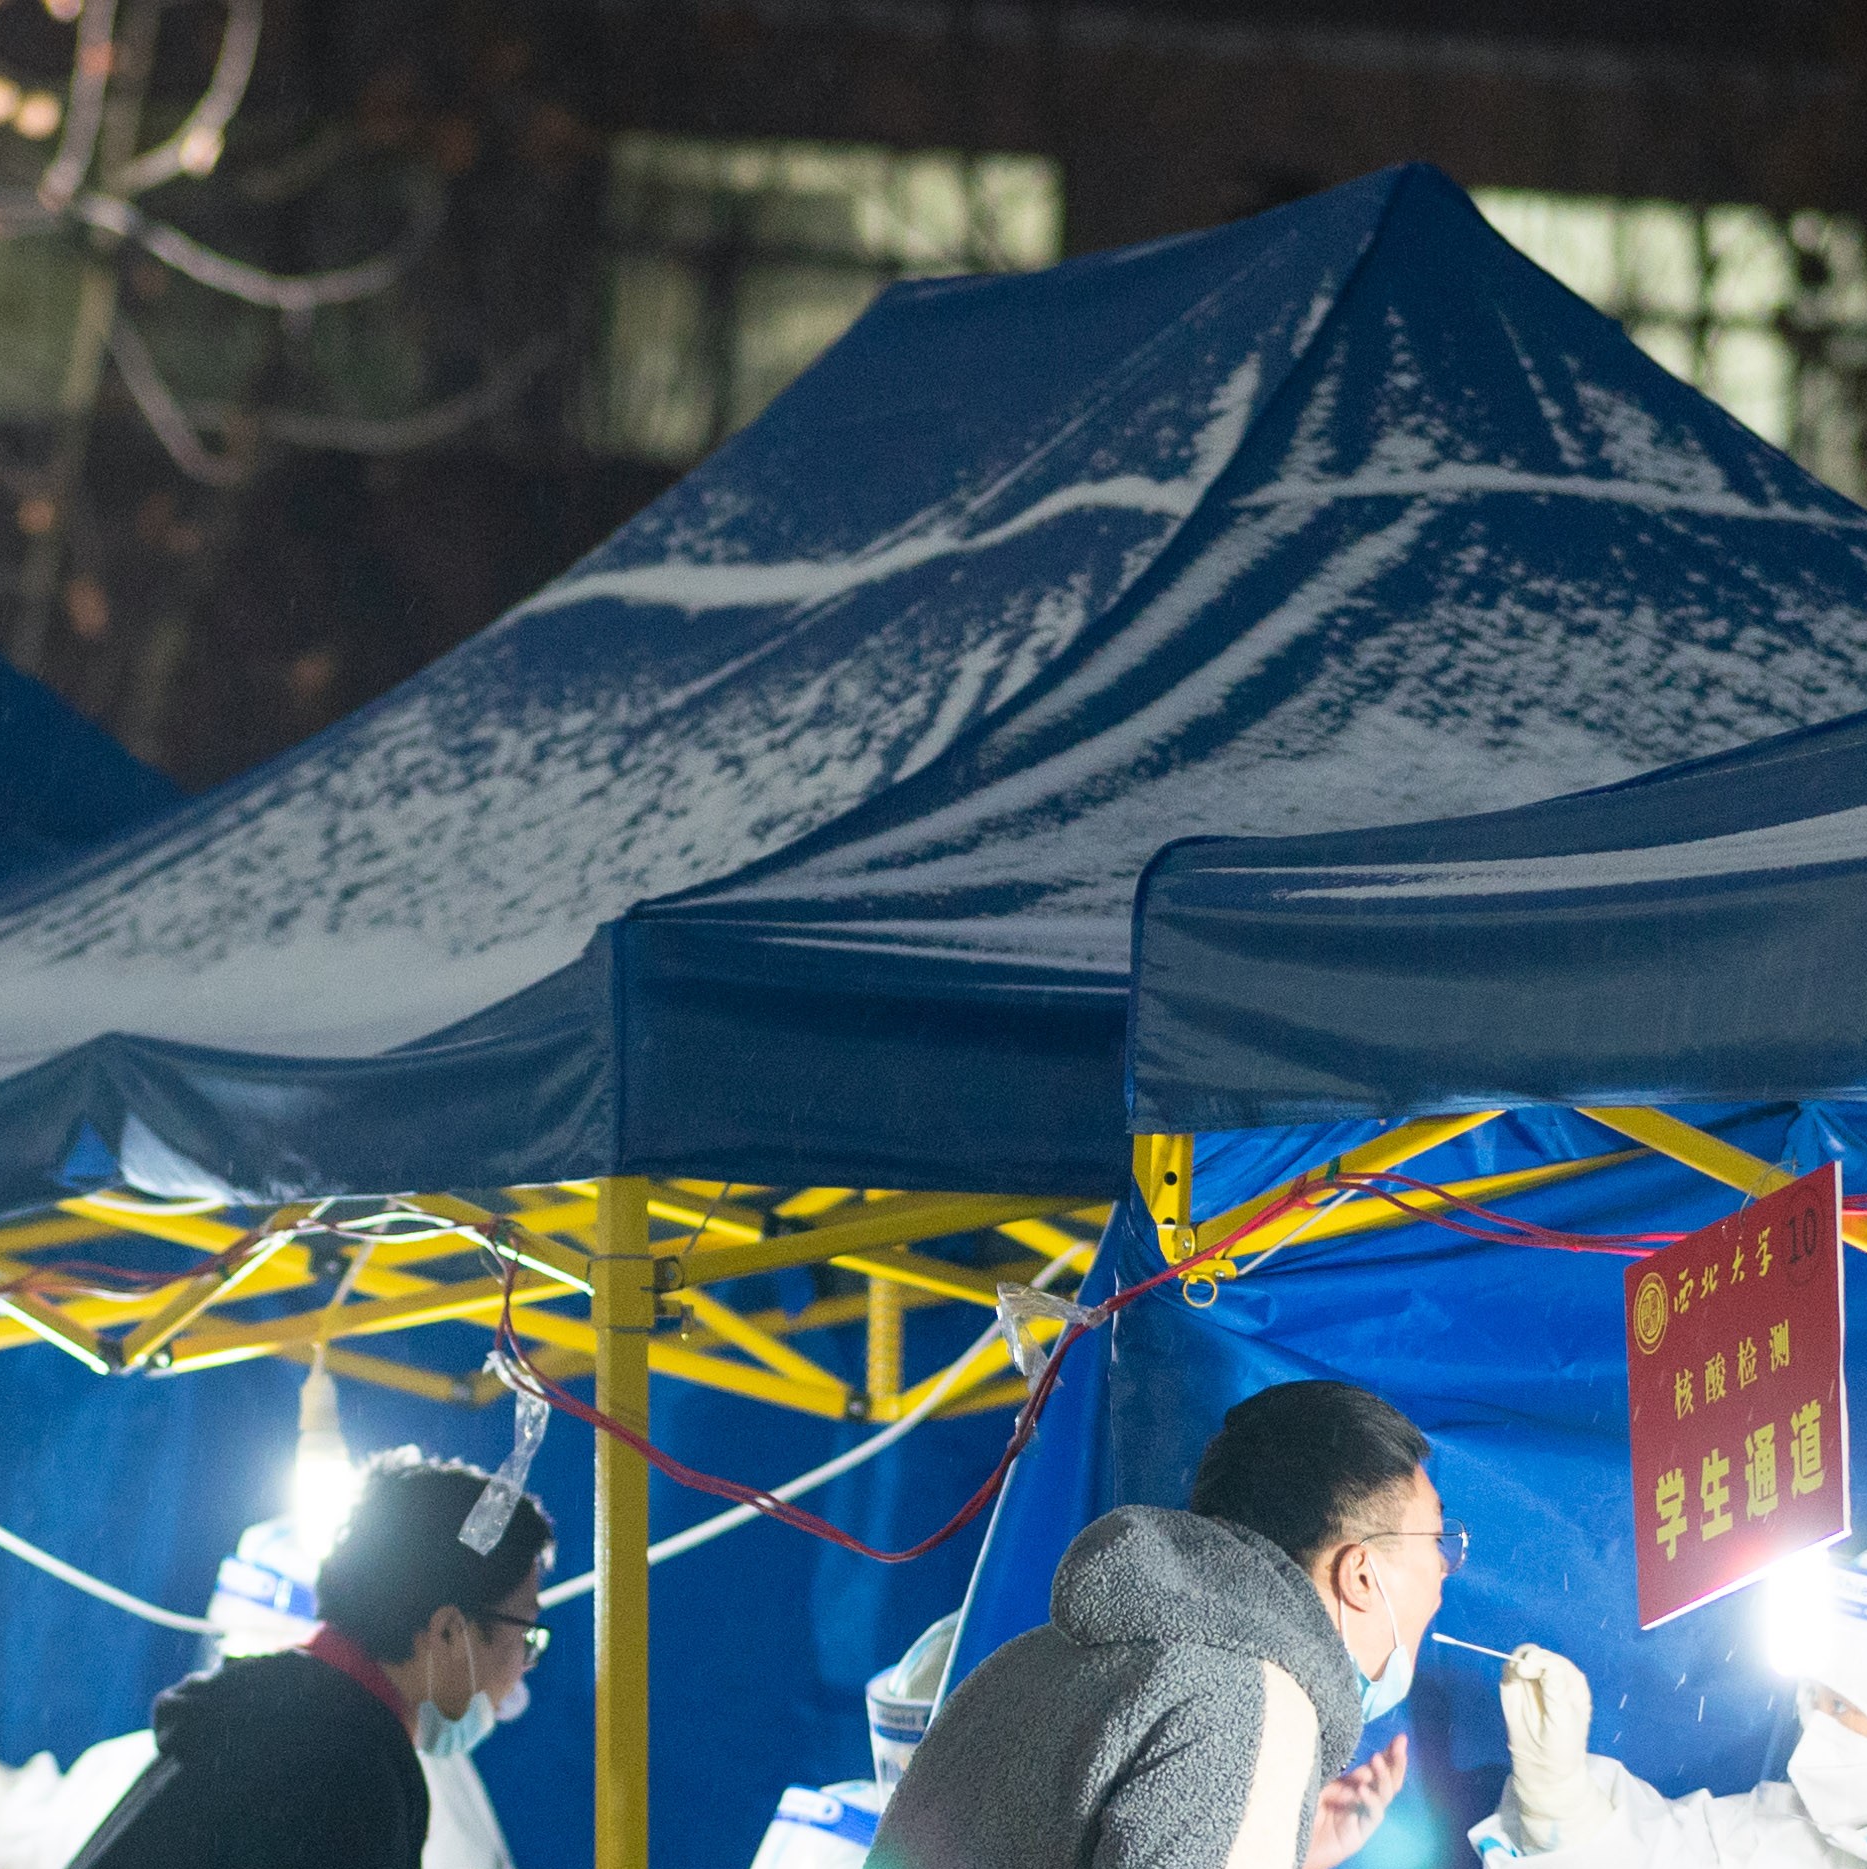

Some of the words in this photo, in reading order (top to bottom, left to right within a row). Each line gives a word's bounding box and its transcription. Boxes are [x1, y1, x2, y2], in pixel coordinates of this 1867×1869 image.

[1672, 1225, 1774, 1315] 西北大学
[1785, 1205, 1819, 1266] 10
[1673, 1318, 1792, 1421] 核酸检测
[1654, 1398, 1825, 1562] 学生通道
